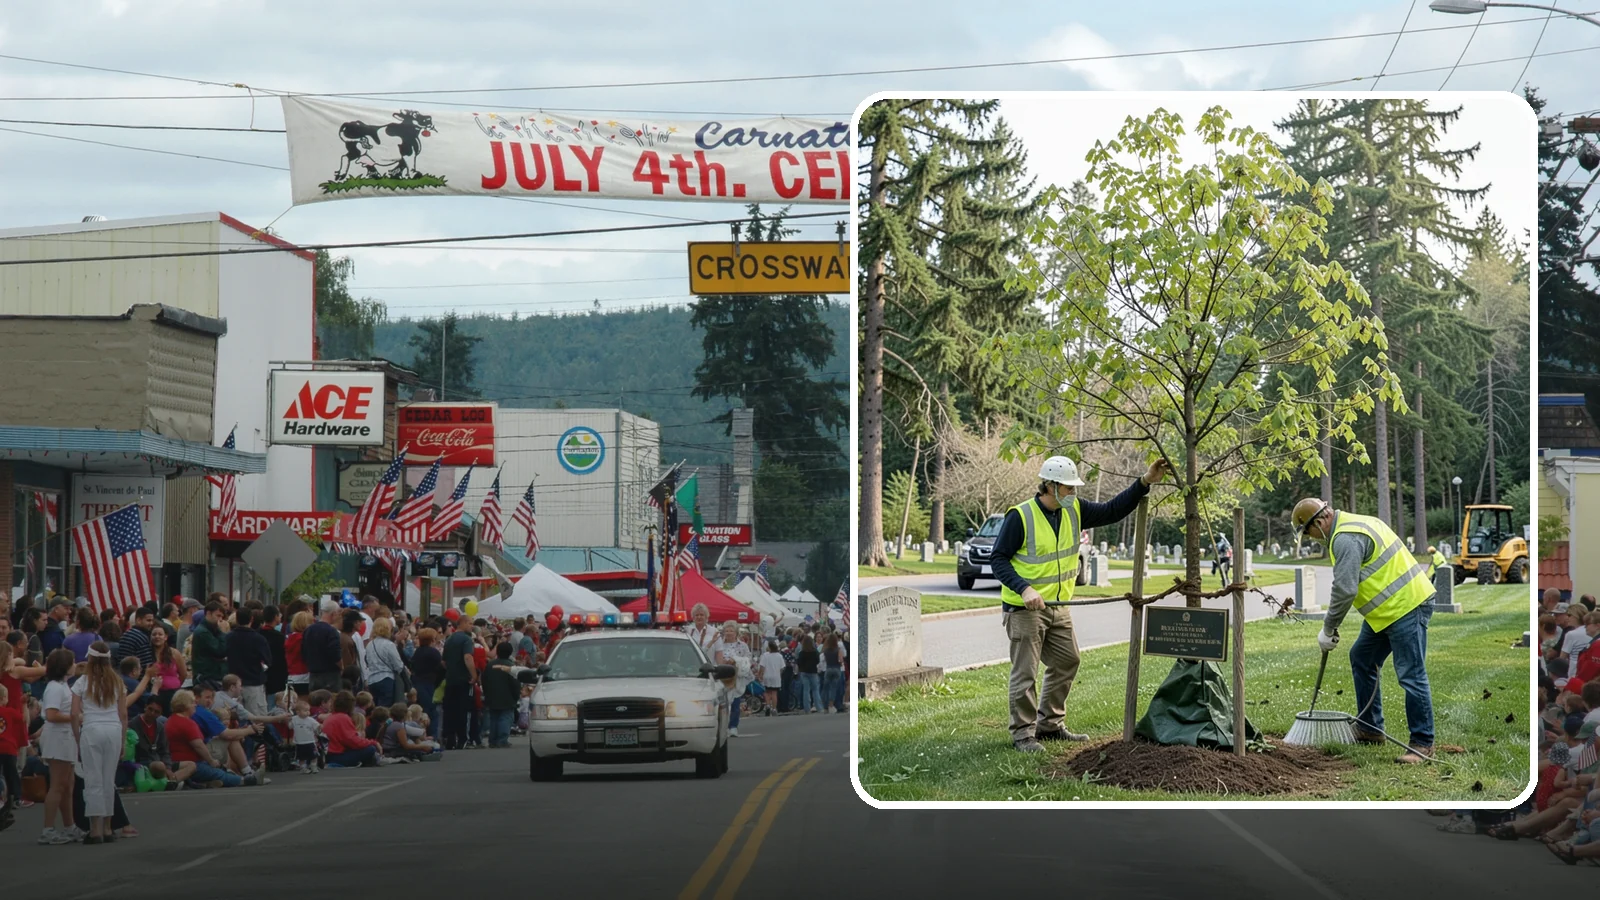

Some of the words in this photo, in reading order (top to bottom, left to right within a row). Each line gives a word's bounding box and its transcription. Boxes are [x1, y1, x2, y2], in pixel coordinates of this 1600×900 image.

[694, 121, 850, 149] Carnat
[481, 141, 605, 192] JULY
[632, 150, 746, 198] 4th.
[696, 254, 850, 280] CROSSWA
[283, 380, 373, 420] ACE
[405, 409, 452, 422] CEDAR
[283, 421, 371, 436] Hardware
[416, 428, 477, 447] Coca-Cola
[356, 467, 385, 479] Simpl
[83, 485, 93, 494] St.
[96, 485, 124, 494] Vincent
[126, 486, 136, 494] de
[138, 486, 155, 495] Paul
[688, 526, 741, 534] CRNATION
[699, 535, 730, 543] GLASS
